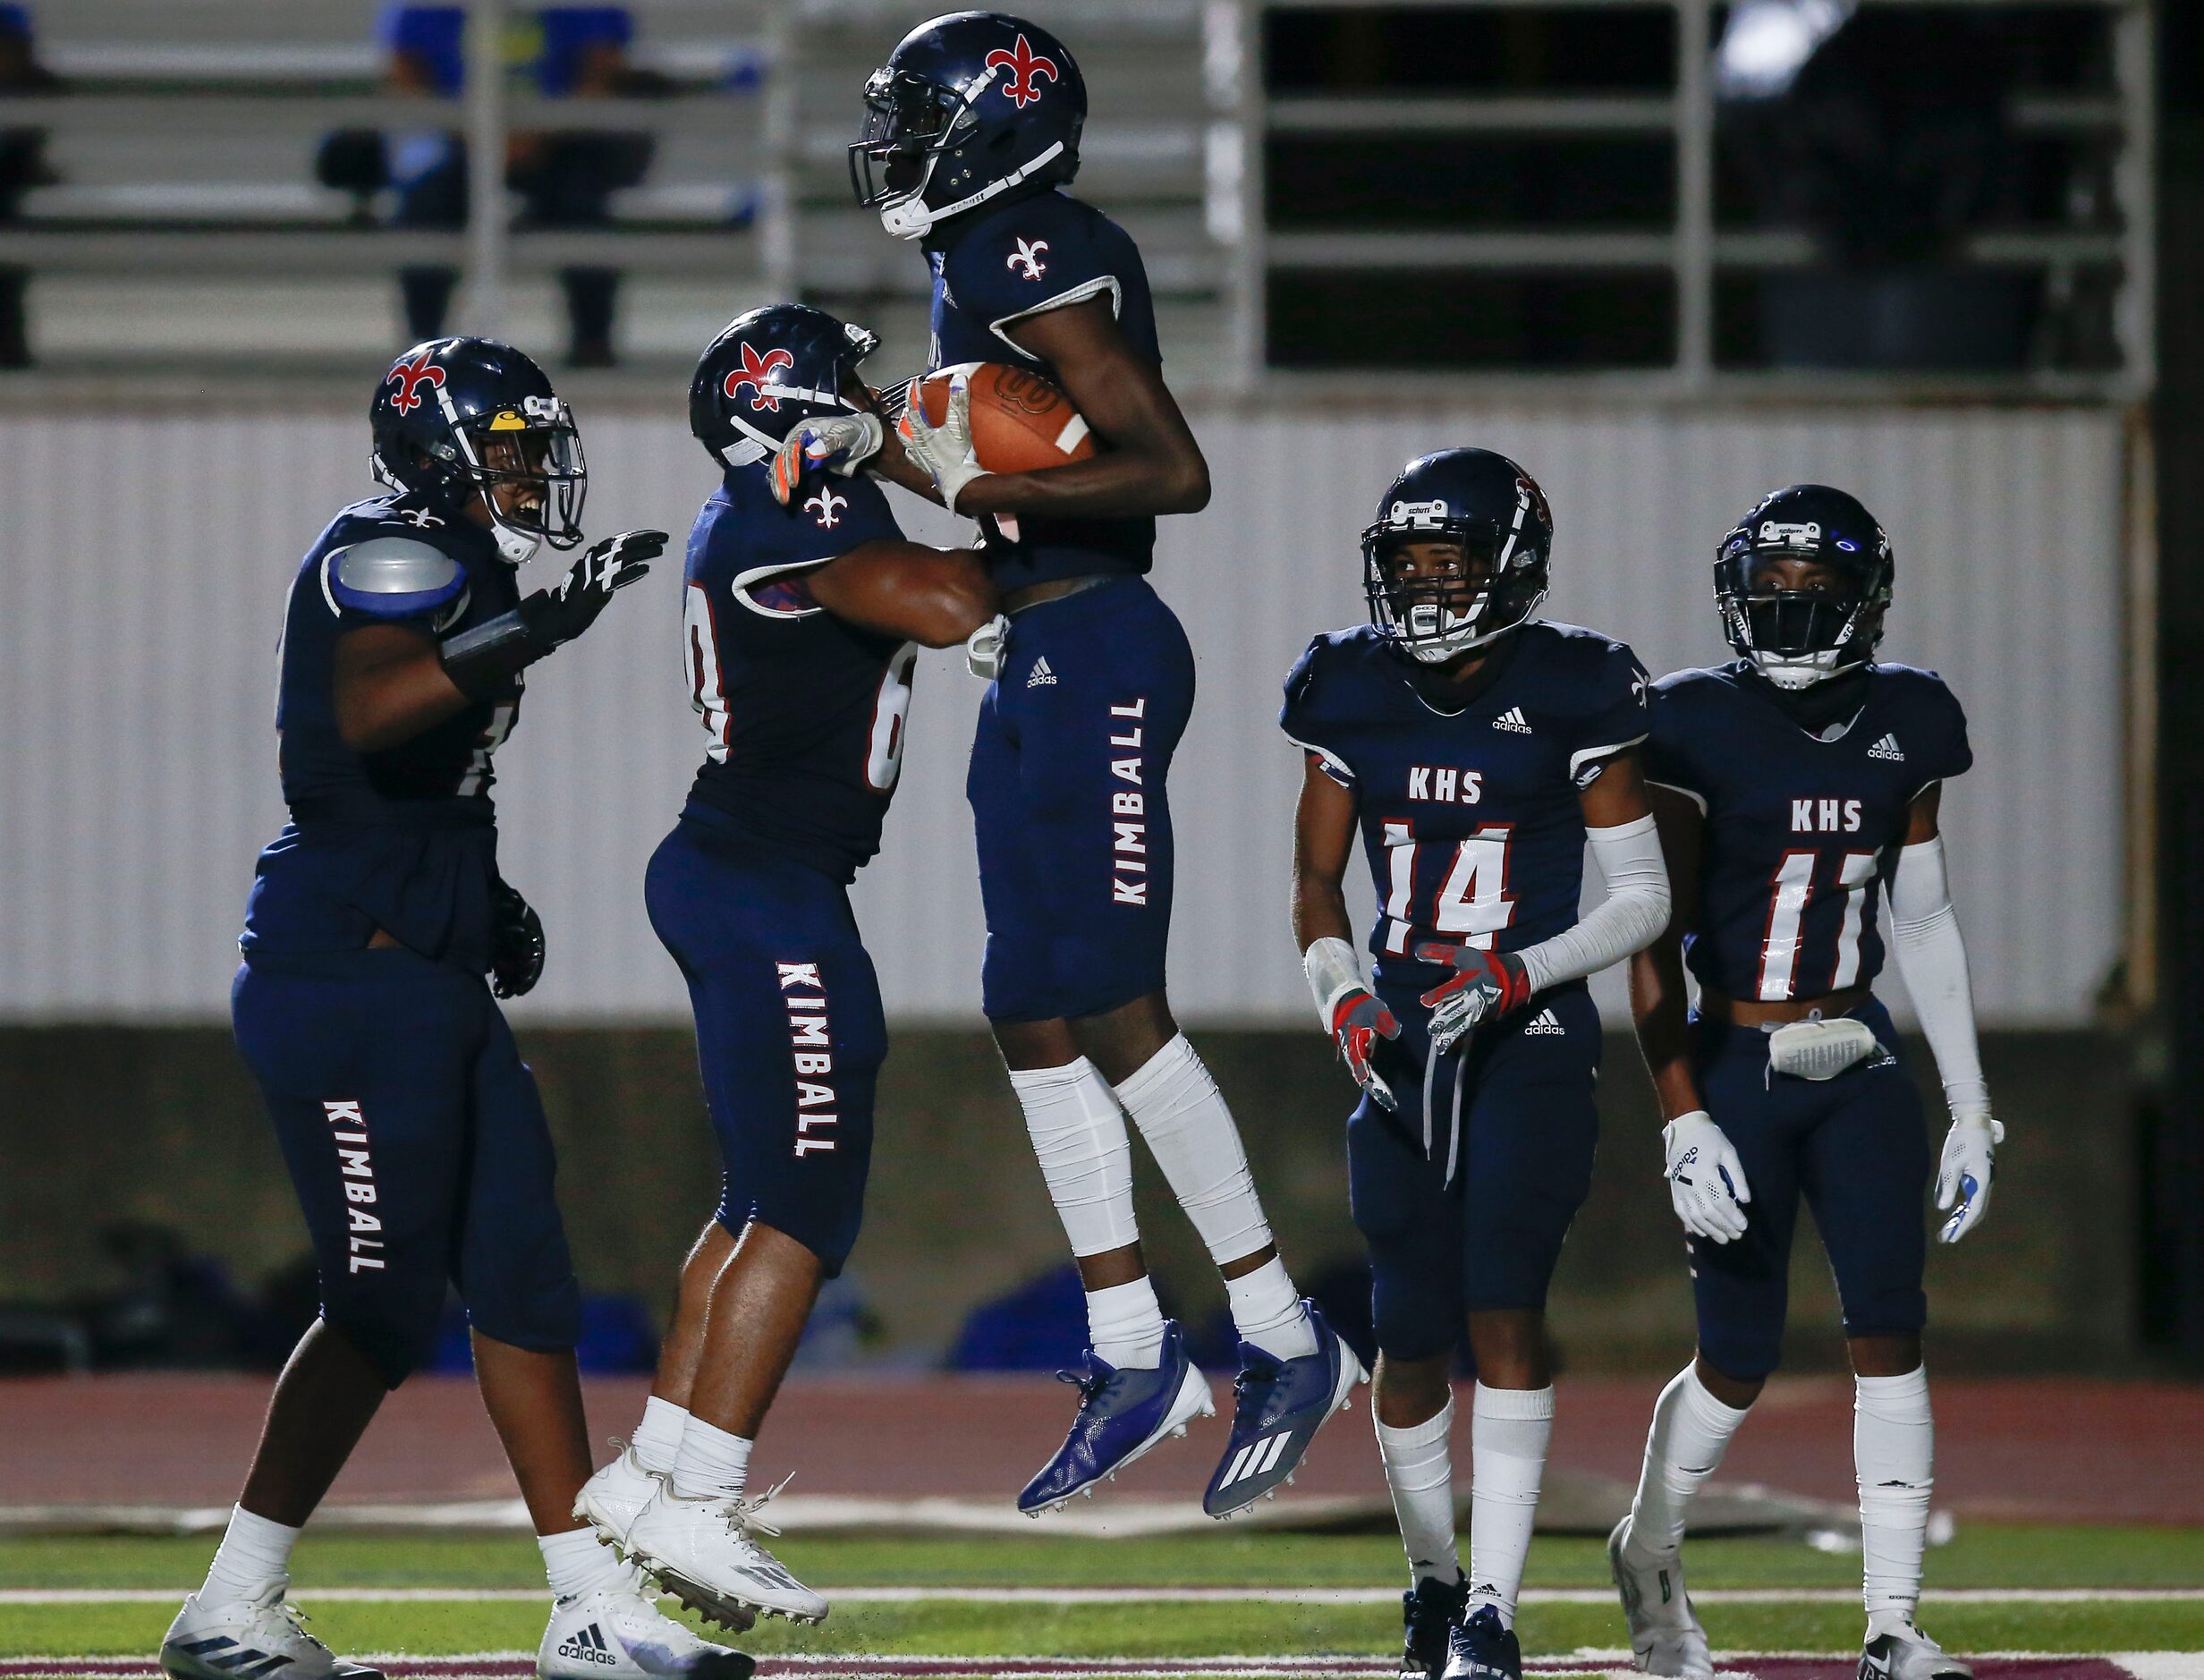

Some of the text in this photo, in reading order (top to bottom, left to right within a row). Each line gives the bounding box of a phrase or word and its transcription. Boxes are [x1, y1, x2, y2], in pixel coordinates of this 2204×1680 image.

[1027, 674, 1057, 688] adidas
[1492, 721, 1532, 734] adidas
[1867, 748, 1905, 761] adidas
[1110, 697, 1146, 905] KIMBALL
[1408, 766, 1483, 804] KHS
[1791, 799, 1862, 833] KHS
[1382, 819, 1516, 955] 14
[1524, 1023, 1565, 1035] adidas
[776, 961, 838, 1158] KIMBALL
[323, 1100, 386, 1275] KIMBALL
[558, 1644, 616, 1666] adidas
